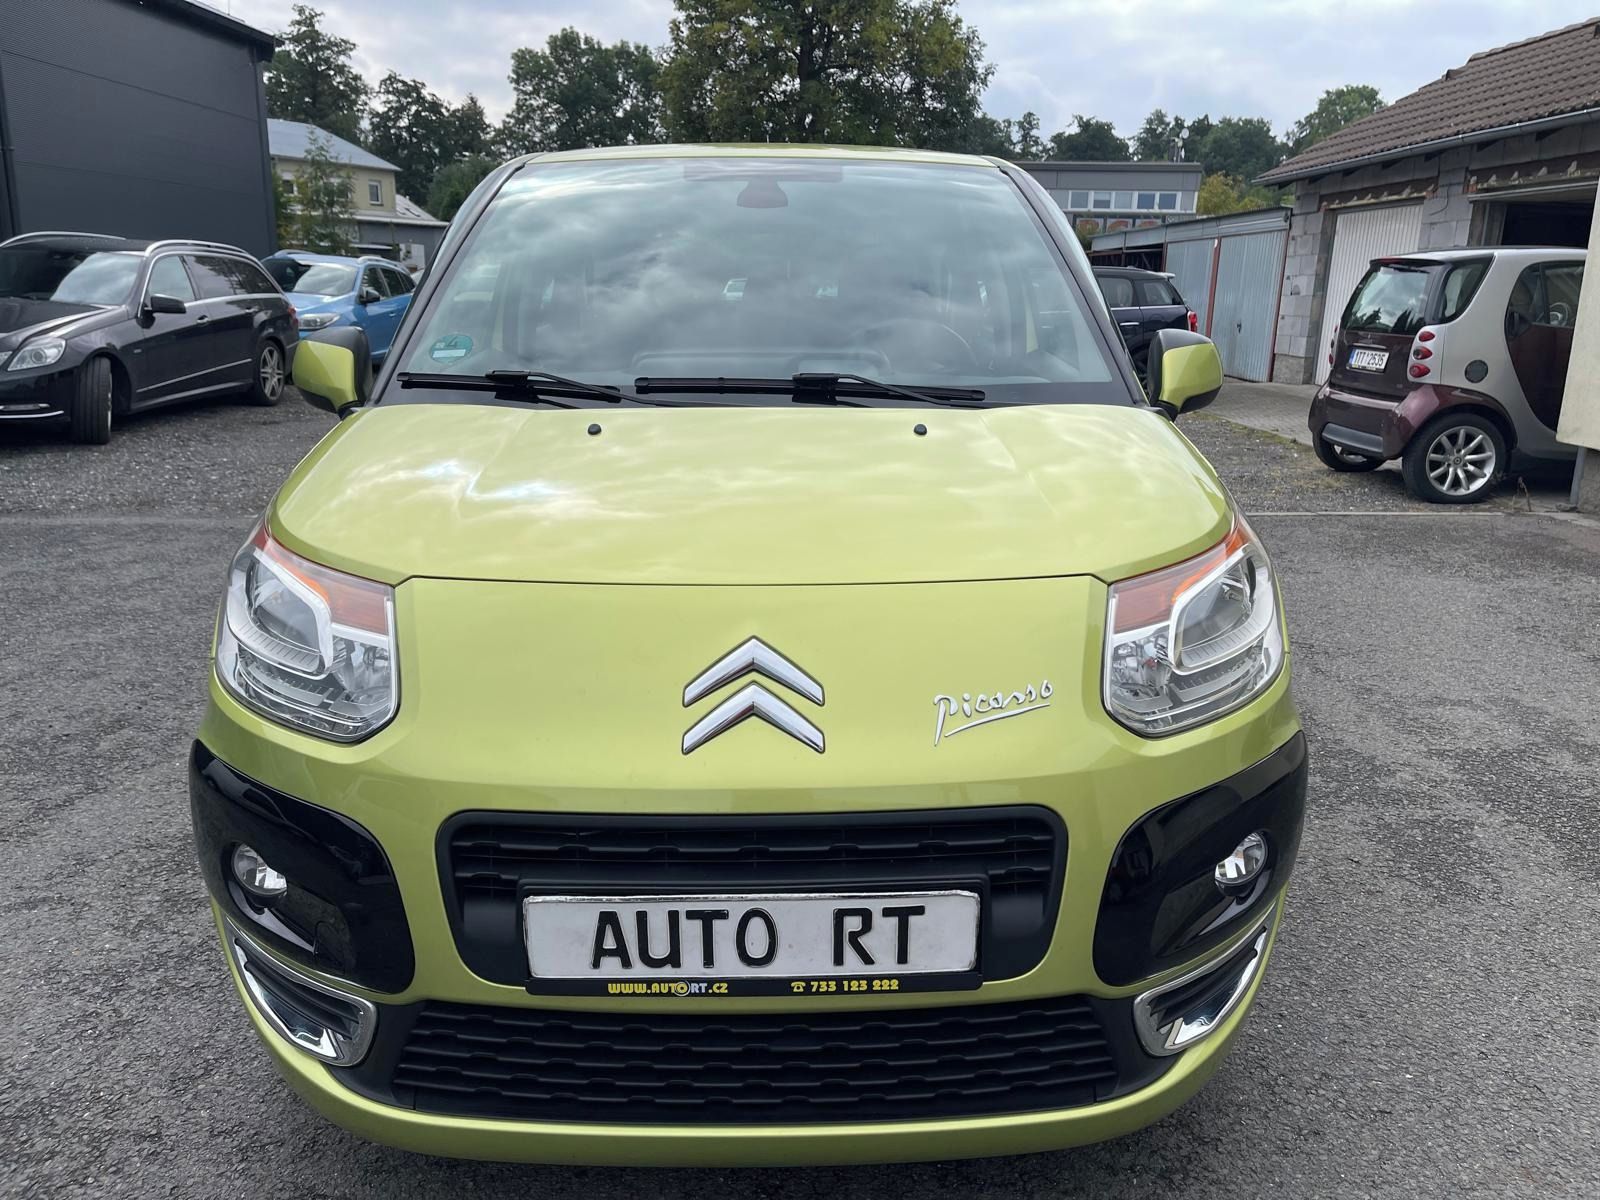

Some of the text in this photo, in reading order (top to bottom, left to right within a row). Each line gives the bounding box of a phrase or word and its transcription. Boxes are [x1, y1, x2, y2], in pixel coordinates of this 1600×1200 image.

[933, 679, 1054, 747] Picasso
[590, 905, 926, 969] AUTO RT
[810, 978, 899, 993] 733 123 222
